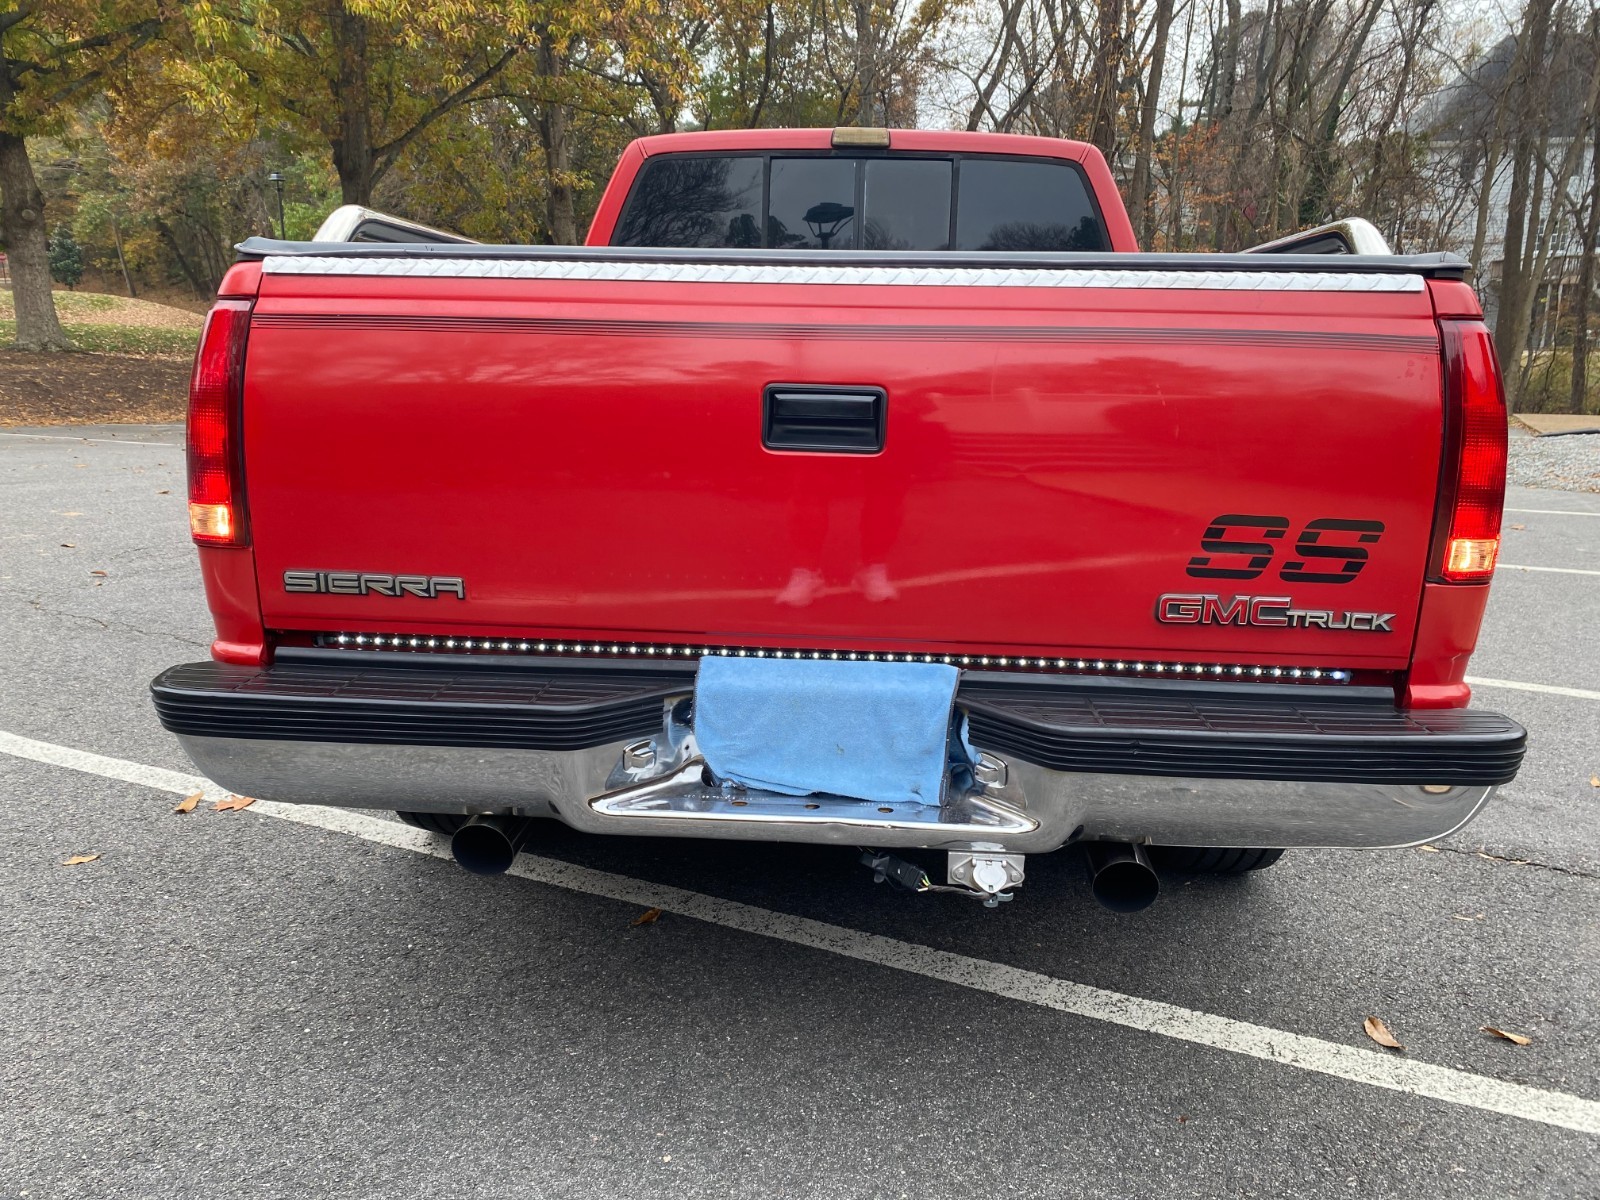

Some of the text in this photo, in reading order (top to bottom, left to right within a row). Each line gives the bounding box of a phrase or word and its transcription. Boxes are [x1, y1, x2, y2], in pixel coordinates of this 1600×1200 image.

[1185, 513, 1386, 585] SS
[284, 570, 465, 599] SIERRA
[1157, 593, 1397, 632] GMC TRUCK
